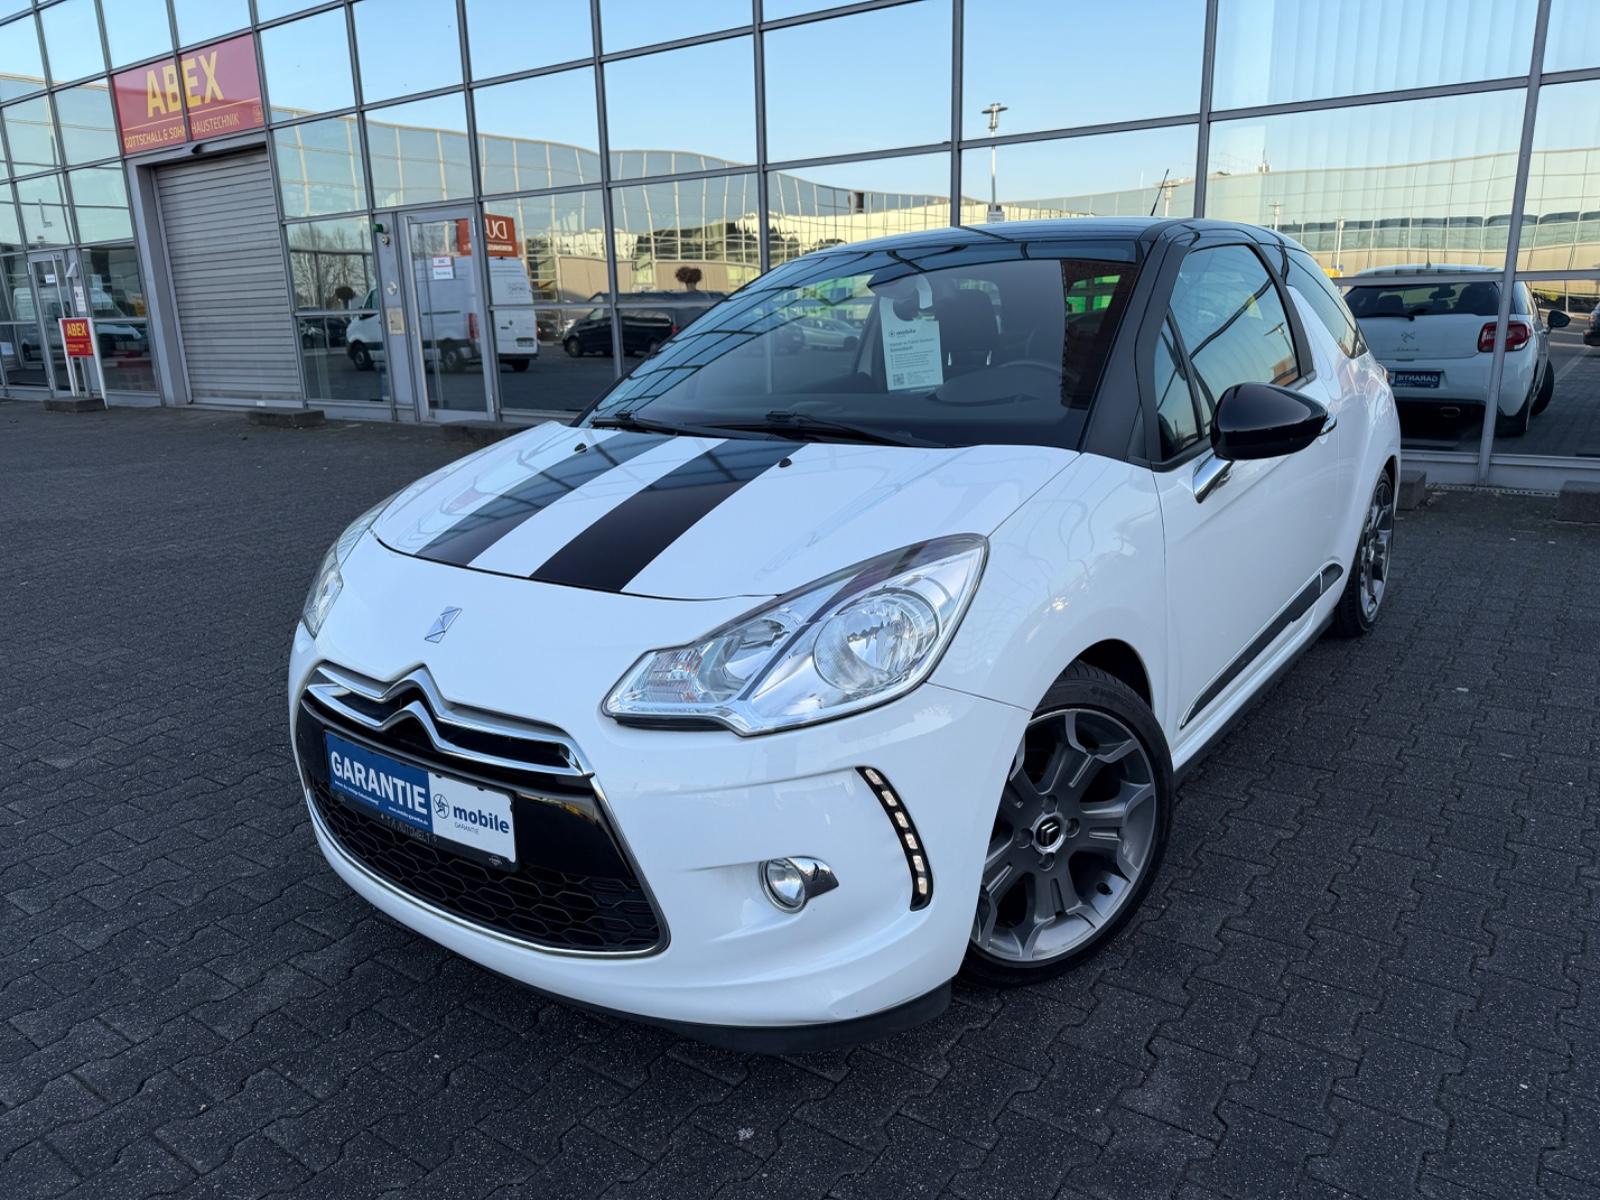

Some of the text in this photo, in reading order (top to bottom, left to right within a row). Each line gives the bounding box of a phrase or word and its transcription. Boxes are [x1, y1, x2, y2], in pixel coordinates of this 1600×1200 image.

[146, 51, 224, 118] ABEX
[191, 112, 240, 134] HAUSTECHNIK
[66, 322, 87, 337] ABEX
[331, 751, 428, 815] GARANTIE
[453, 805, 510, 834] mobile
